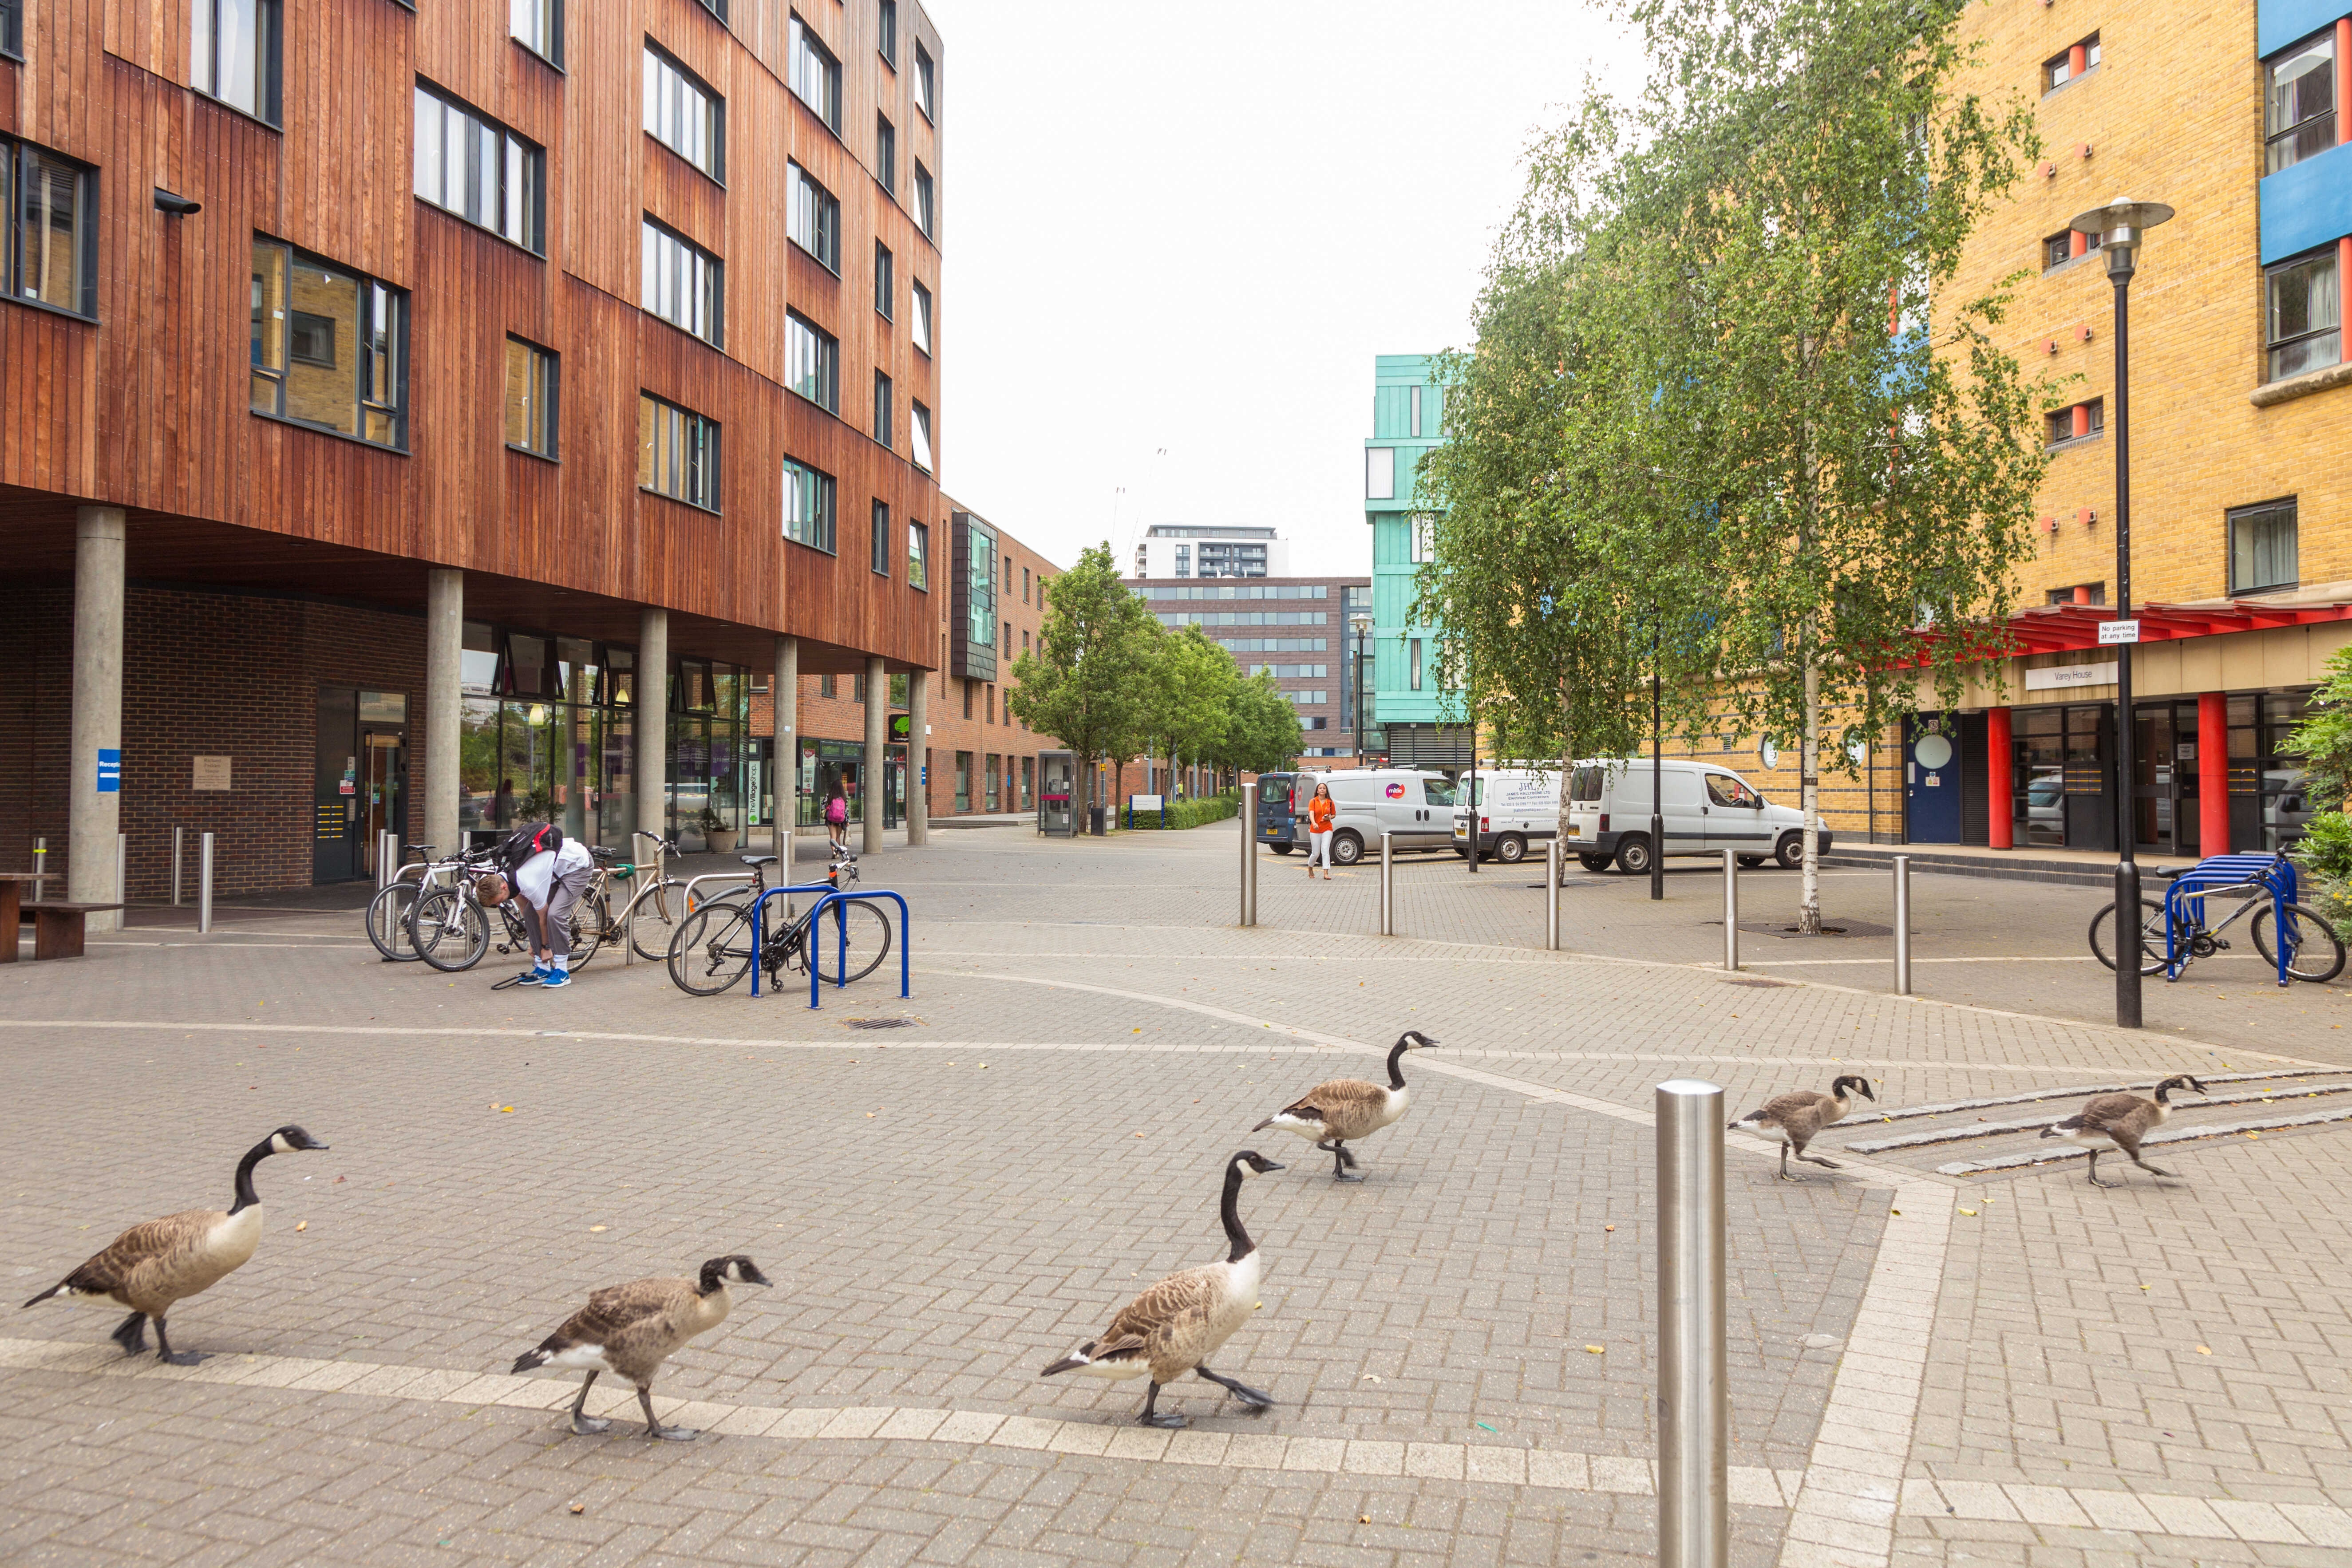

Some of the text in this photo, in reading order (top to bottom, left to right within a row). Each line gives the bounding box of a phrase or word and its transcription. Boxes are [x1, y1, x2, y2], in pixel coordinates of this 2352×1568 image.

[2055, 671, 2092, 681] Varey House
[1519, 782, 1536, 791] JHL
